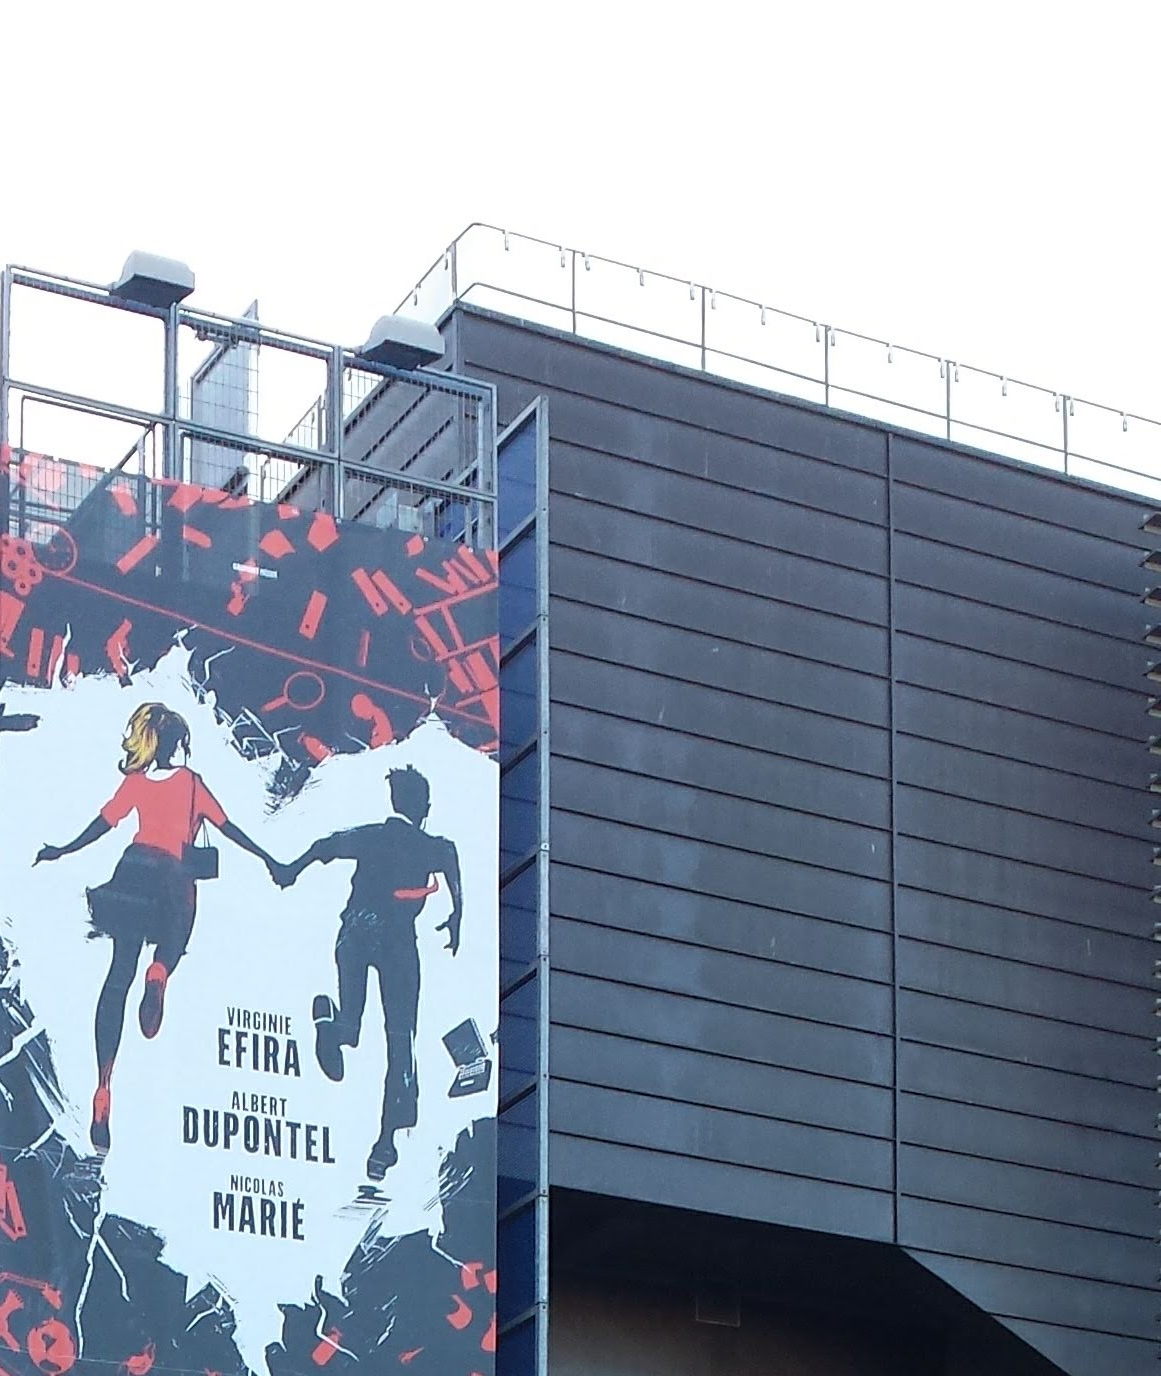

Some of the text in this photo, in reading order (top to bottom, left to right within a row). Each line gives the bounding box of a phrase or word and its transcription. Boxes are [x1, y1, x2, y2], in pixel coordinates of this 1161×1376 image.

[227, 1006, 292, 1035] VIRGINIE
[217, 1027, 301, 1078] EFIRA
[231, 1091, 287, 1117] ALBERT
[182, 1106, 335, 1164] DUPONTEL
[230, 1174, 284, 1198] NICOLAS
[213, 1191, 305, 1241] MARIÉ
